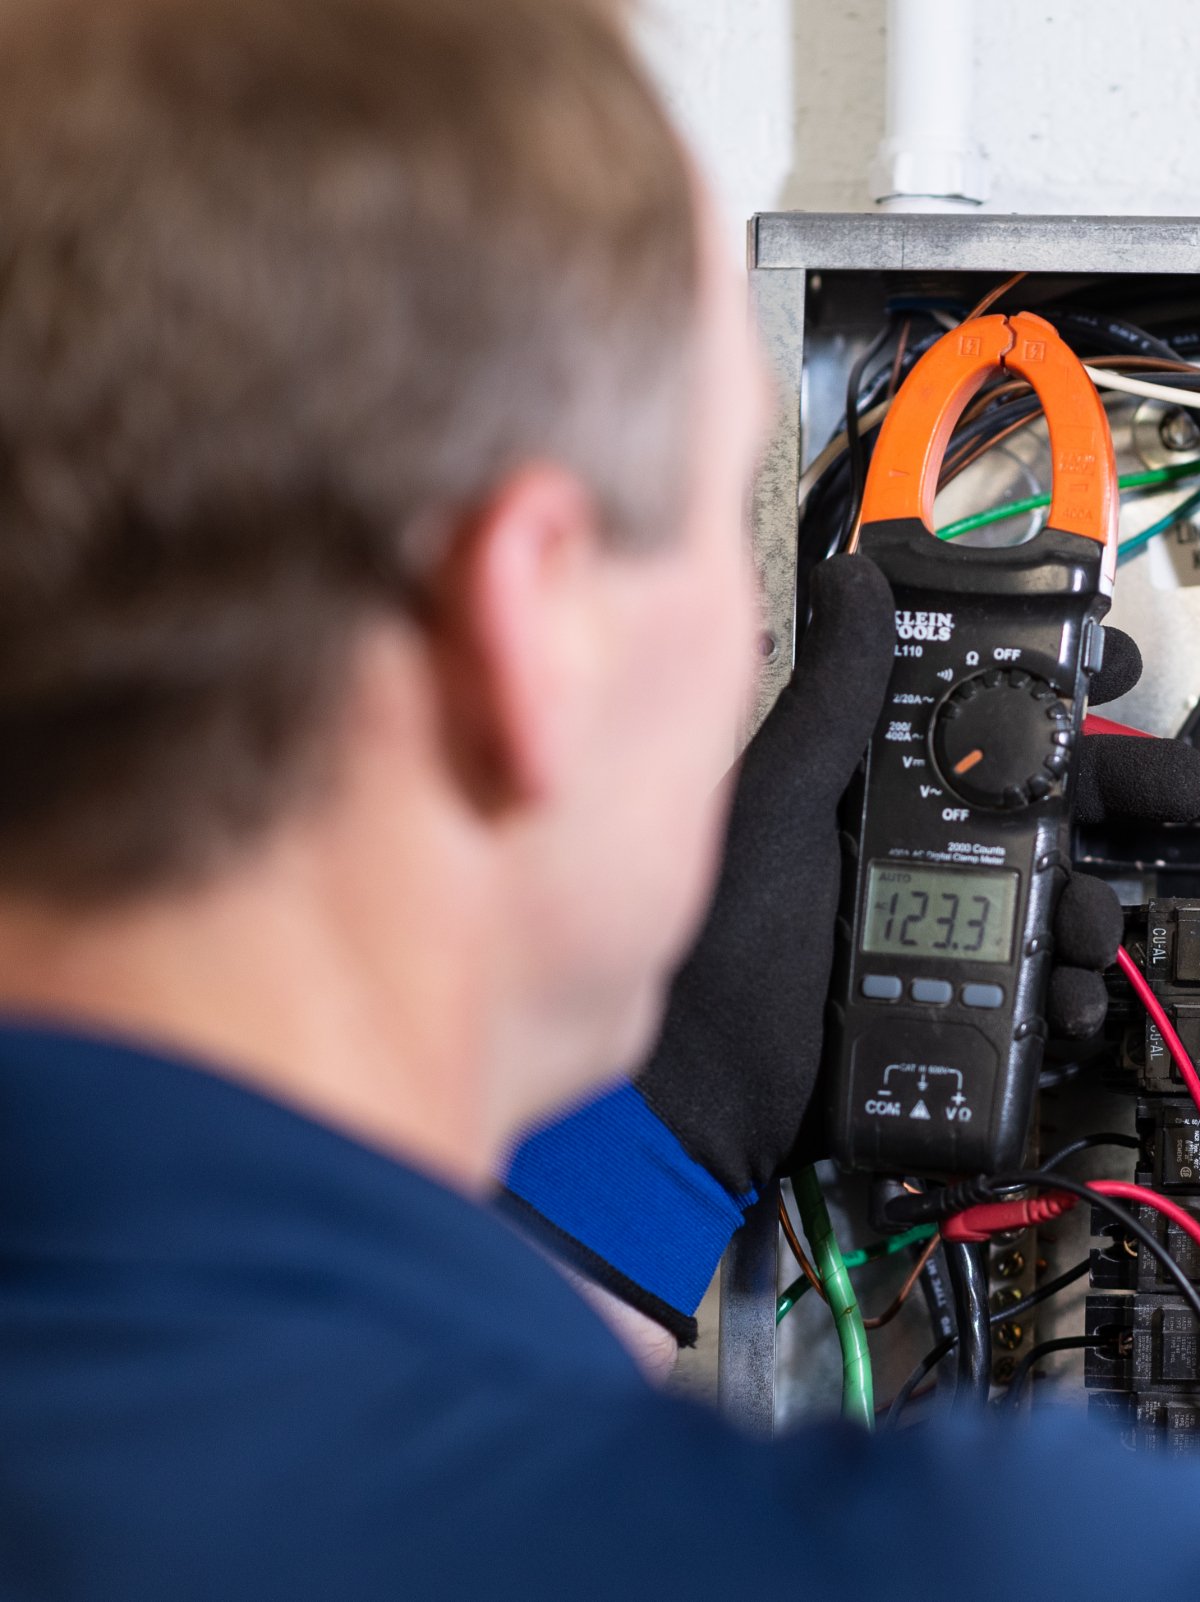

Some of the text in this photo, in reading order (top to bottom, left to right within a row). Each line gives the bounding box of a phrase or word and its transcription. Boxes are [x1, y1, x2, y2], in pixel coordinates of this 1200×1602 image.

[896, 625, 952, 642] OOLS
[994, 648, 1021, 661] OFF
[942, 808, 970, 821] OFF
[879, 872, 912, 883] AUTO
[1153, 928, 1166, 964] CU-AL
[865, 1100, 901, 1115] COM
